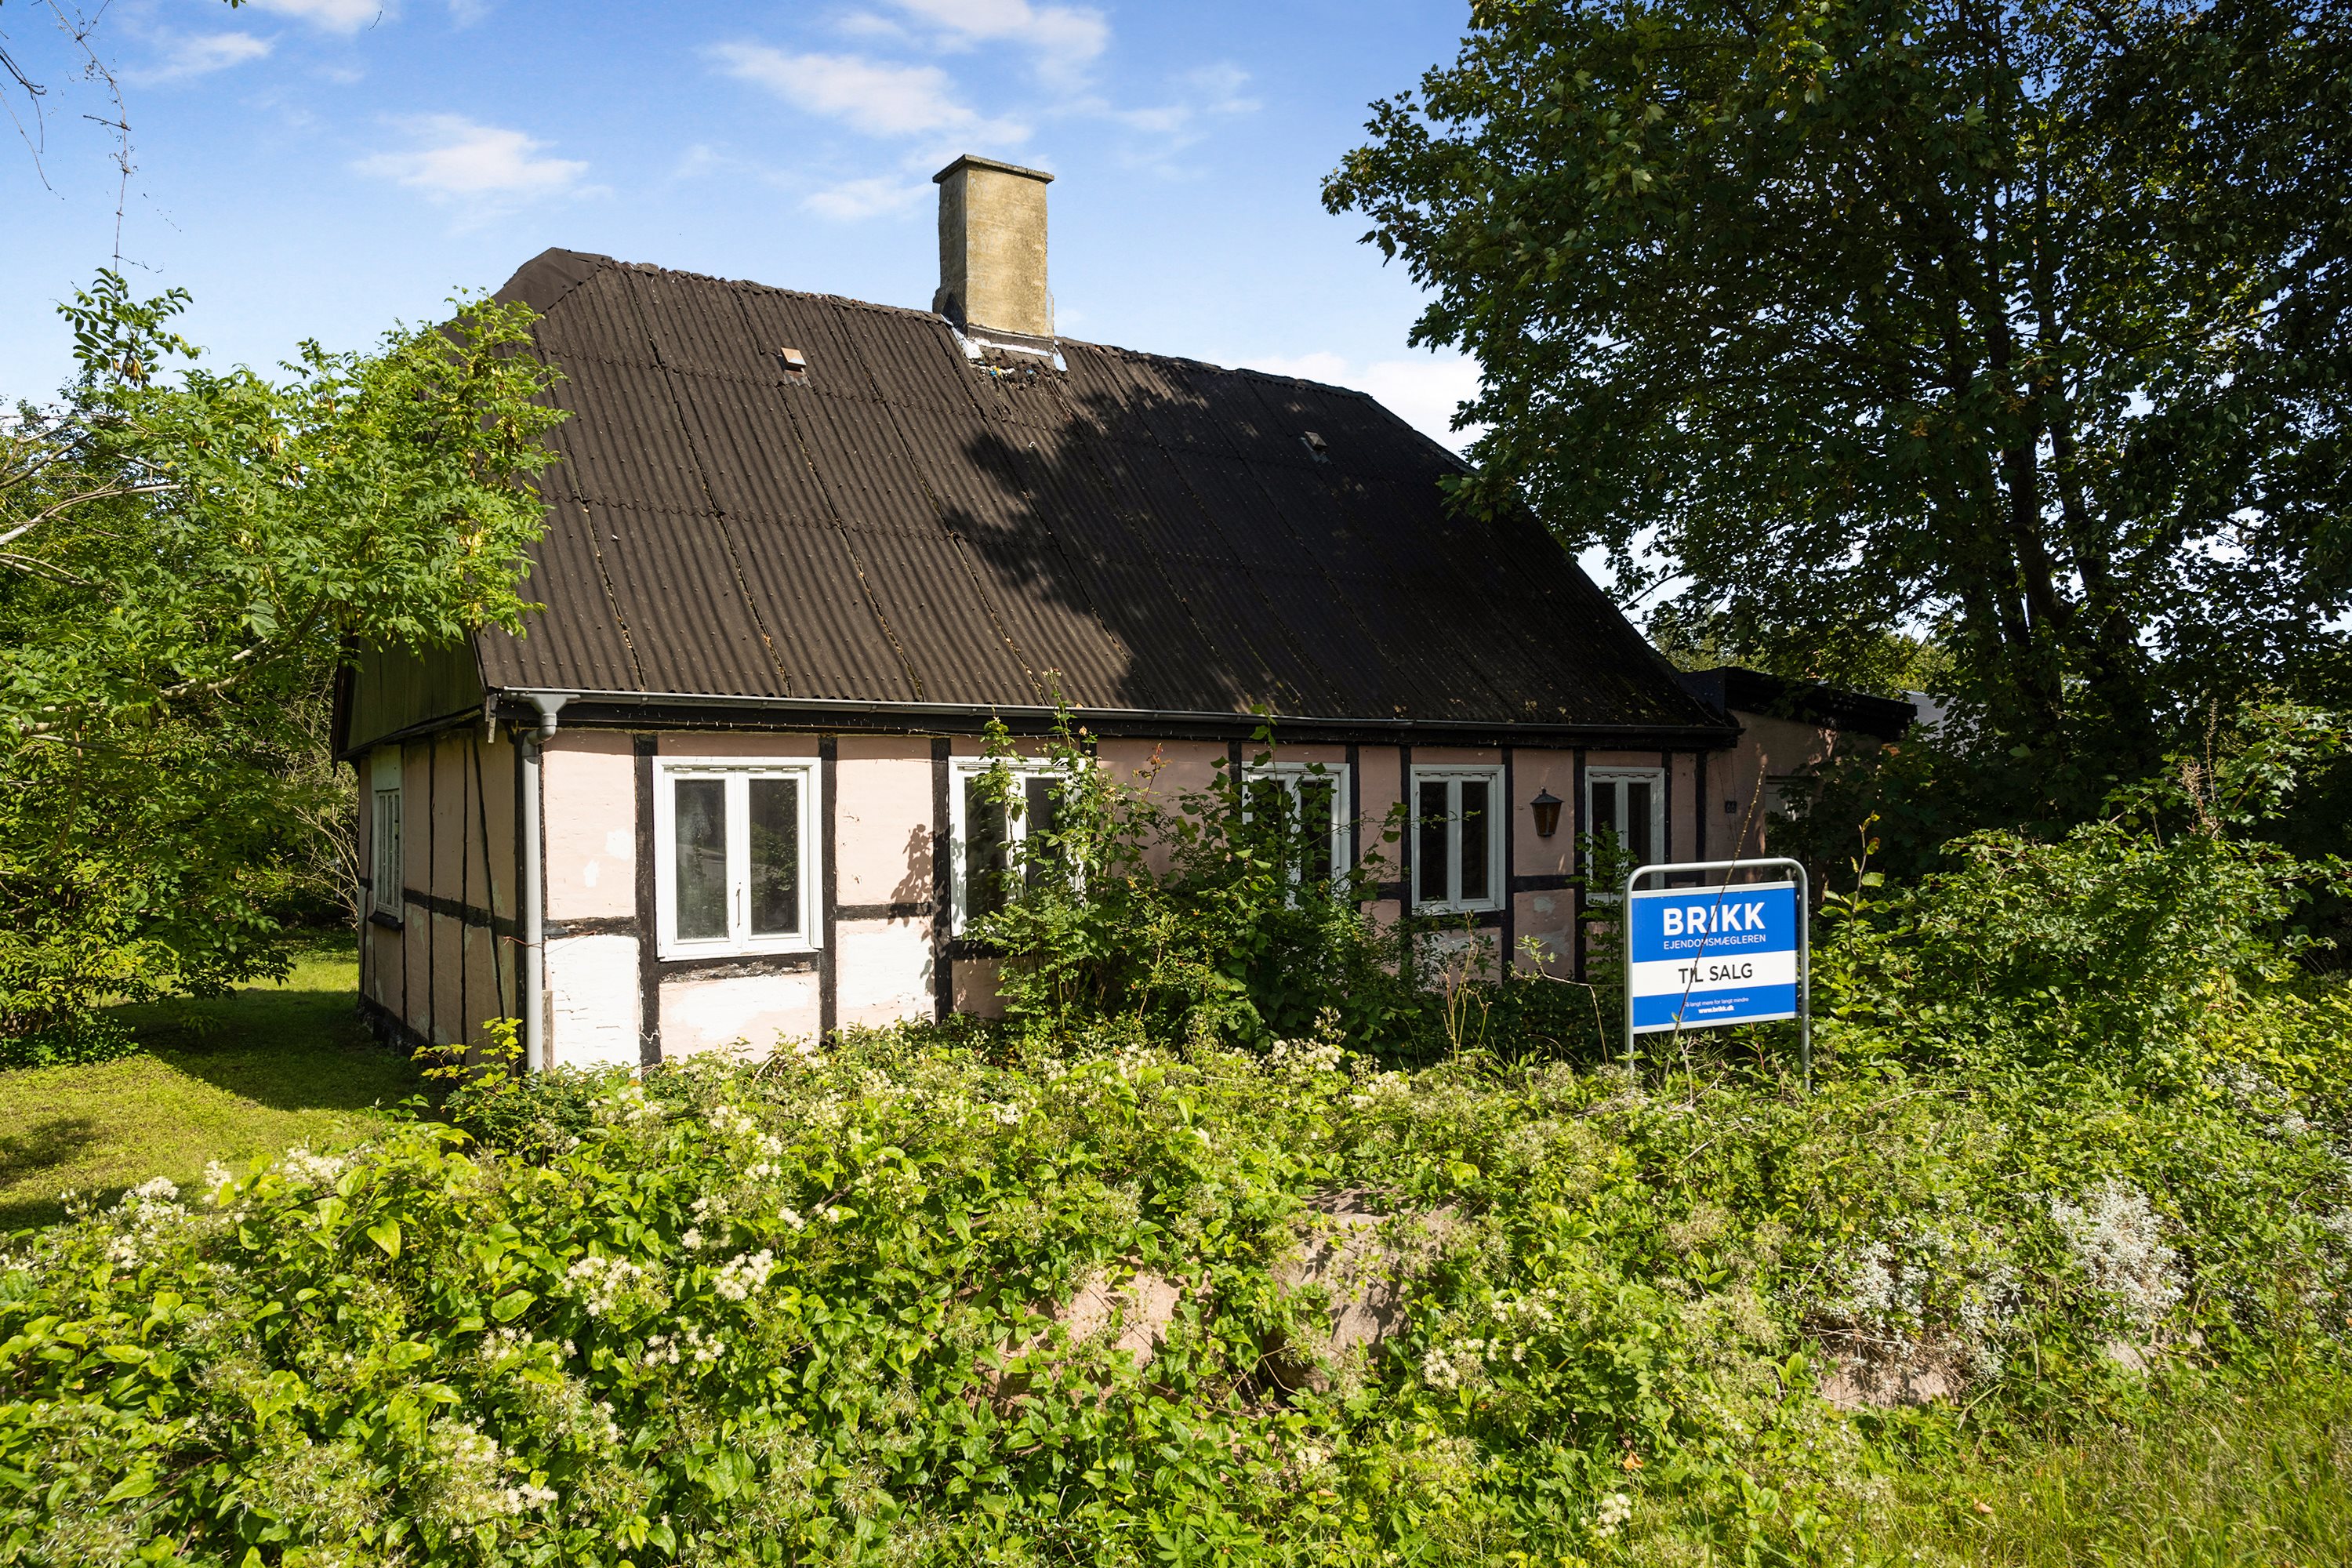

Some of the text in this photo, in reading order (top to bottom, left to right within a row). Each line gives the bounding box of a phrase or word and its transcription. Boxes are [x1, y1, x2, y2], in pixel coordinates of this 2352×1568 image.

[1663, 902, 1766, 935] BRIKK
[1663, 934, 1766, 949] EJENDOMSMÆGLEREN
[1678, 963, 1753, 984] TIL SALG
[1698, 1005, 1734, 1014] www.brikk.dk
